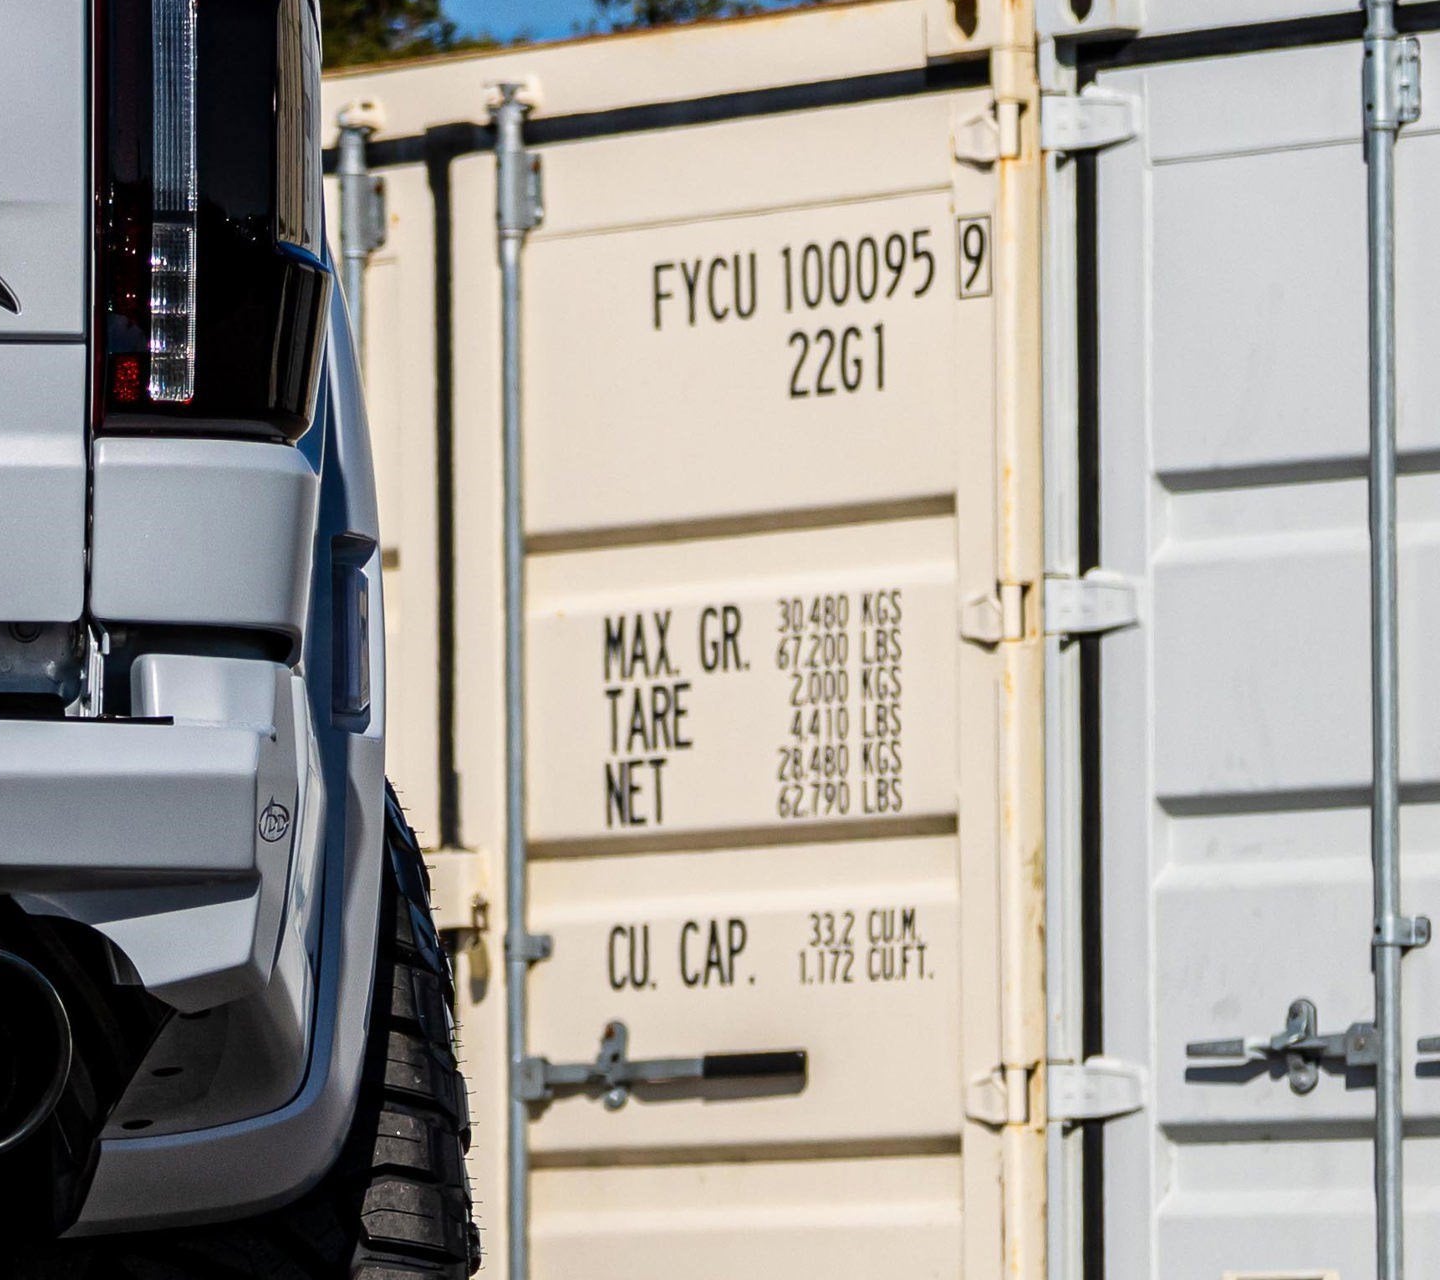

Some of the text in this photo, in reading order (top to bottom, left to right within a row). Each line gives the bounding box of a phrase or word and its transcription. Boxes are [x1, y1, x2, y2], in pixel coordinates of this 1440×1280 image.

[653, 219, 989, 331] FYCU 100095 9
[788, 323, 886, 399] 22G1
[861, 589, 903, 626] KGS
[604, 605, 751, 682] MAX. GR.
[860, 627, 903, 665] LBS
[861, 665, 903, 701] KGS
[604, 681, 692, 755] TARE
[860, 703, 903, 739] LBS
[861, 740, 903, 776] KGS
[604, 757, 668, 828] NET
[860, 777, 903, 815] LBS
[608, 918, 756, 991] CU. CAP.
[799, 949, 855, 984] 1.172
